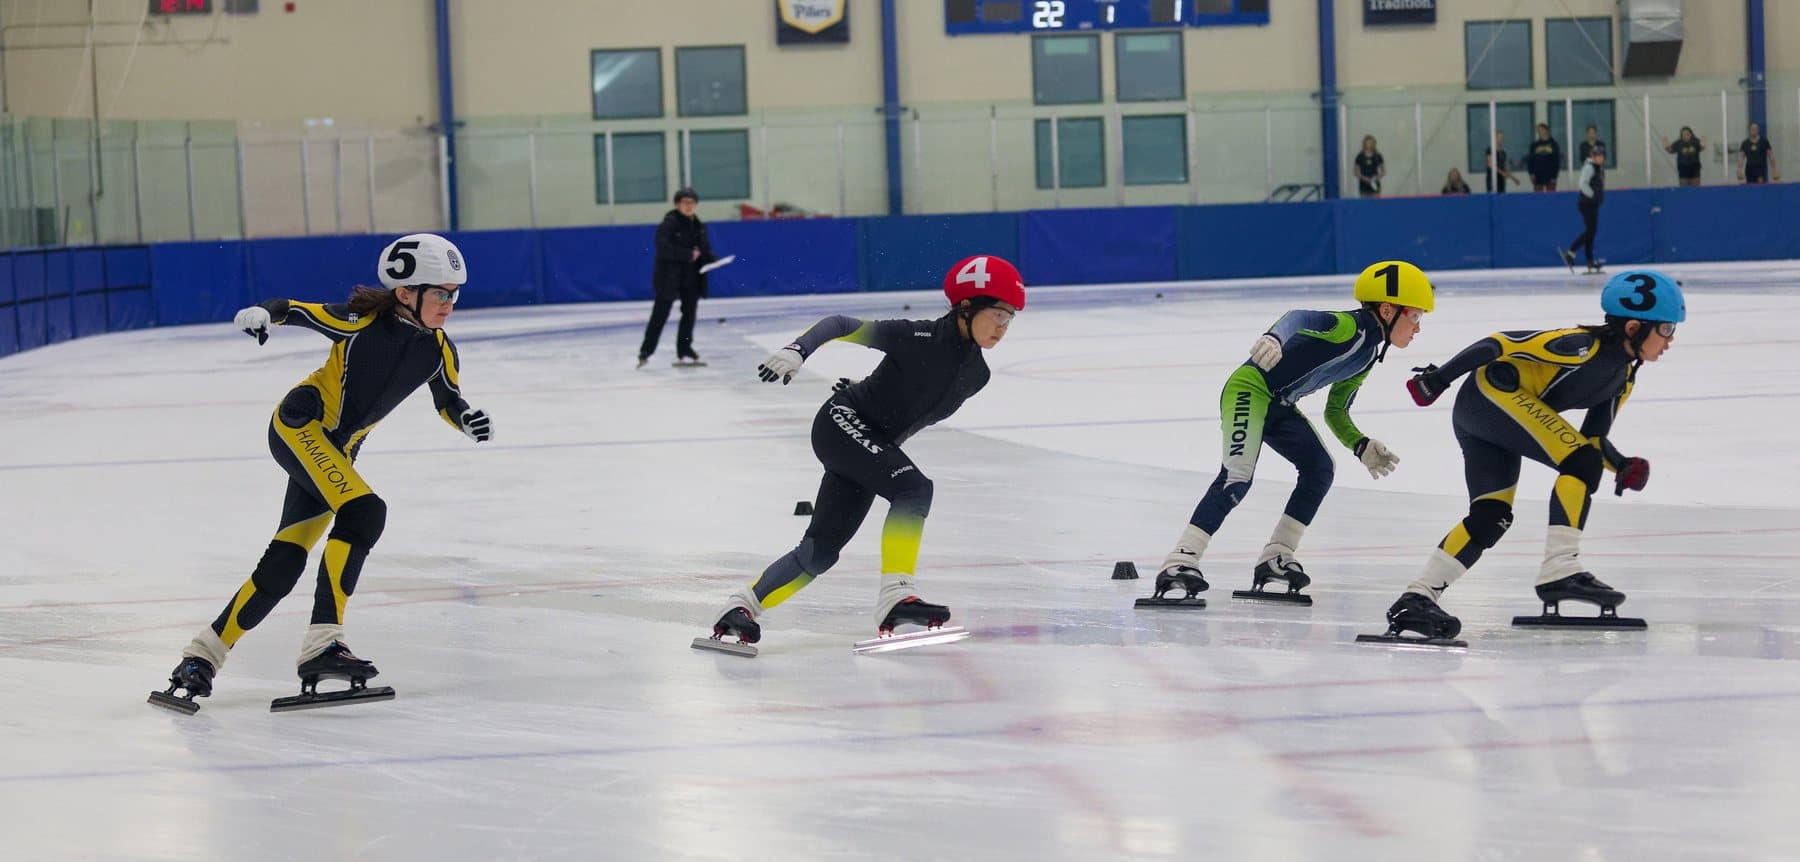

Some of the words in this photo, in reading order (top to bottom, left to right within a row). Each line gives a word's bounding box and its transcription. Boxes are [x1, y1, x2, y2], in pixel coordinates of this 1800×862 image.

[1033, 1, 1065, 28] 22
[1107, 5, 1115, 23] 1
[386, 241, 420, 280] 5
[956, 257, 991, 288] 4
[1374, 265, 1399, 297] 1
[1619, 274, 1657, 312] 3
[1229, 391, 1252, 457] MILTON
[296, 429, 353, 495] HAMILTON
